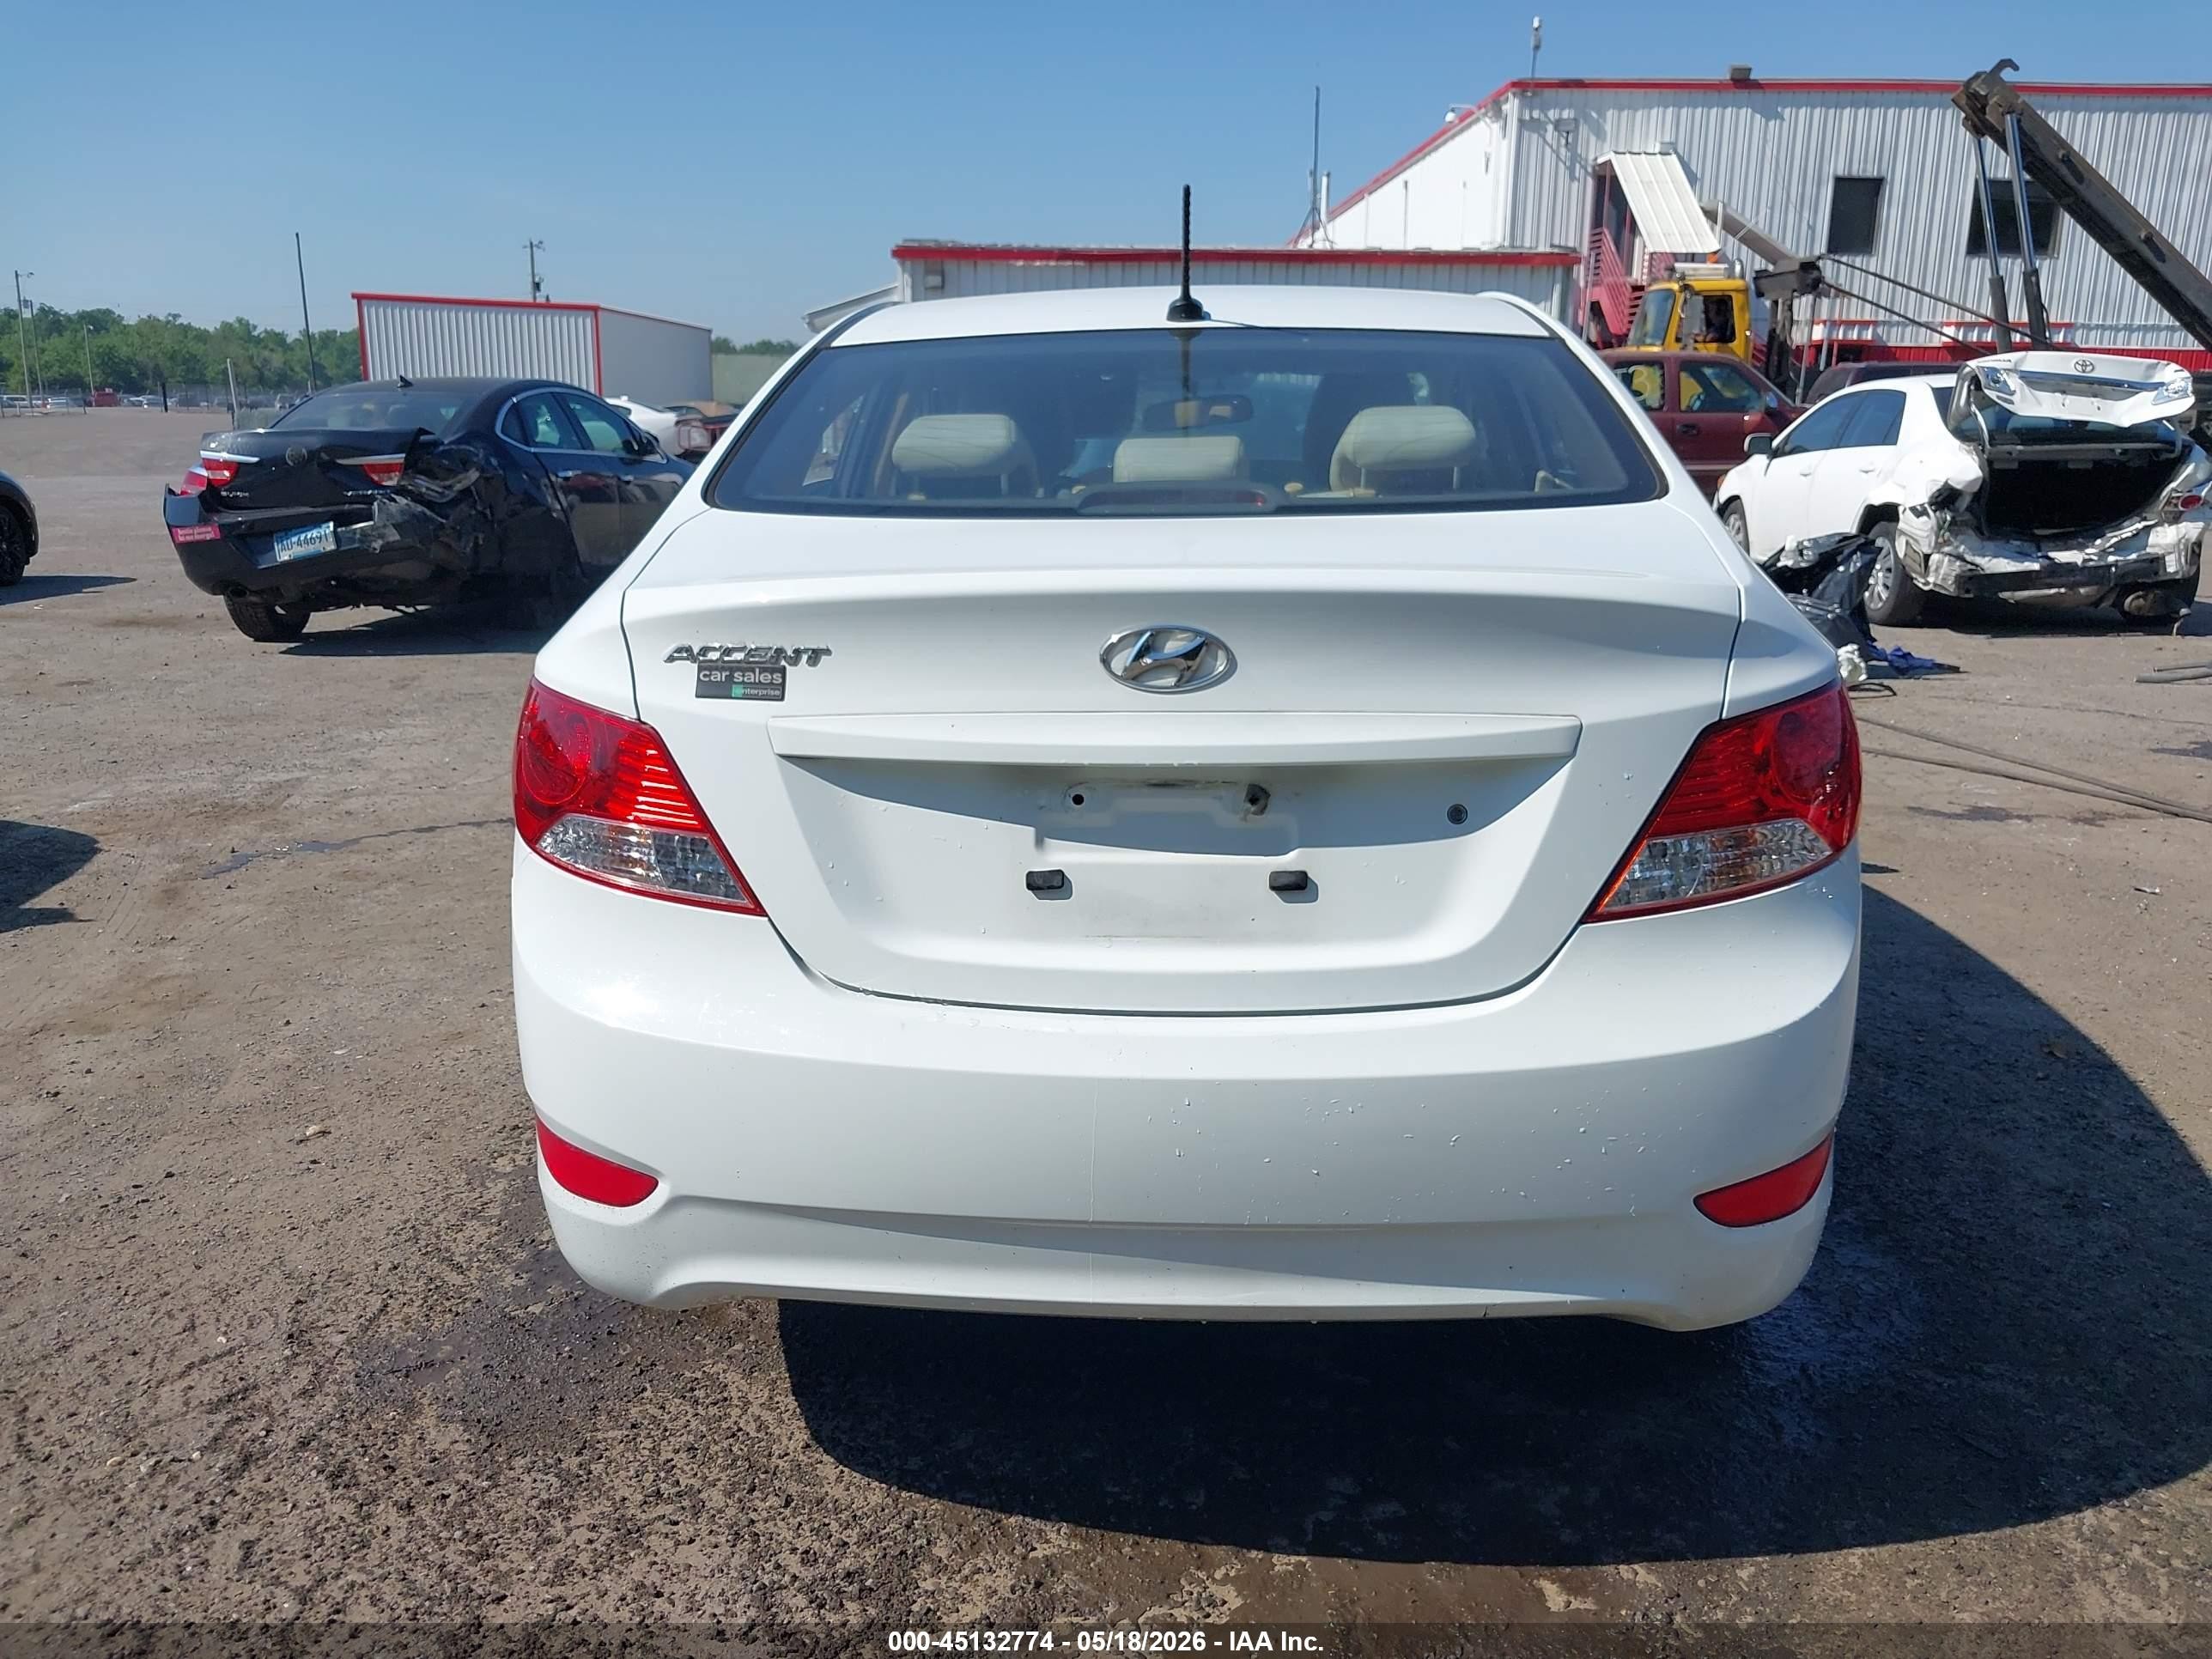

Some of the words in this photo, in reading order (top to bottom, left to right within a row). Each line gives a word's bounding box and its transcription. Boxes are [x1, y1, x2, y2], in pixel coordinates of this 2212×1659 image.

[664, 644, 832, 667] ACCENT
[699, 671, 729, 682] car
[733, 668, 782, 684] sales
[735, 688, 781, 696] nterprise
